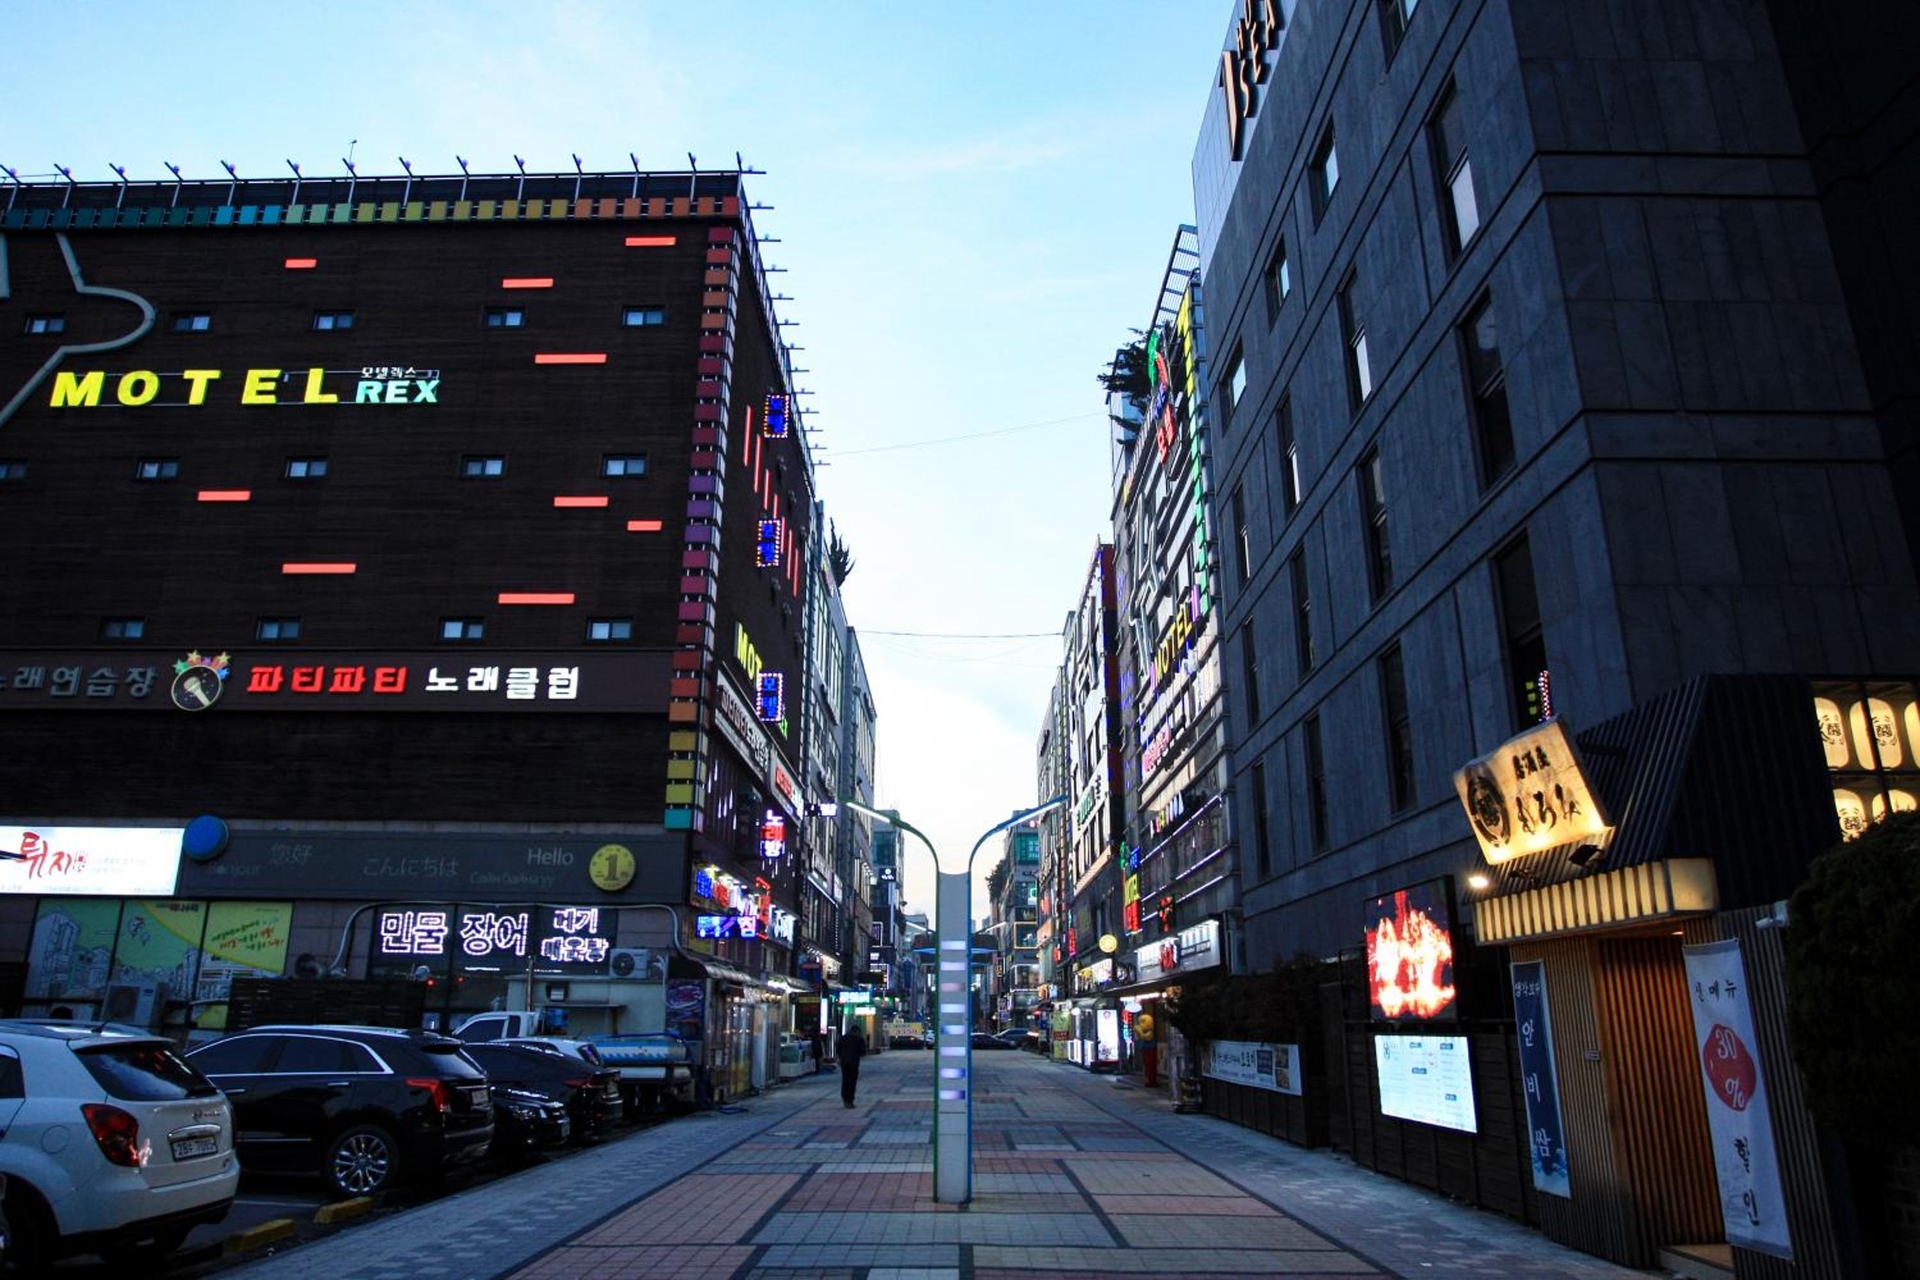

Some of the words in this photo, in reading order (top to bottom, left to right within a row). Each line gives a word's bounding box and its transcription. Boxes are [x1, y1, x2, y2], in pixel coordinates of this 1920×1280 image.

[50, 368, 338, 407] MOTEL
[355, 379, 440, 404] REX
[1154, 601, 1194, 682] MOTEL
[246, 665, 408, 694] 파티파티
[425, 665, 579, 700] 노래클럽
[363, 856, 460, 878] こんにちは
[527, 847, 574, 866] Hello
[381, 911, 448, 954] 민물
[459, 911, 529, 956] 장어
[1714, 1027, 1737, 1060] 30
[1726, 1078, 1746, 1110] %
